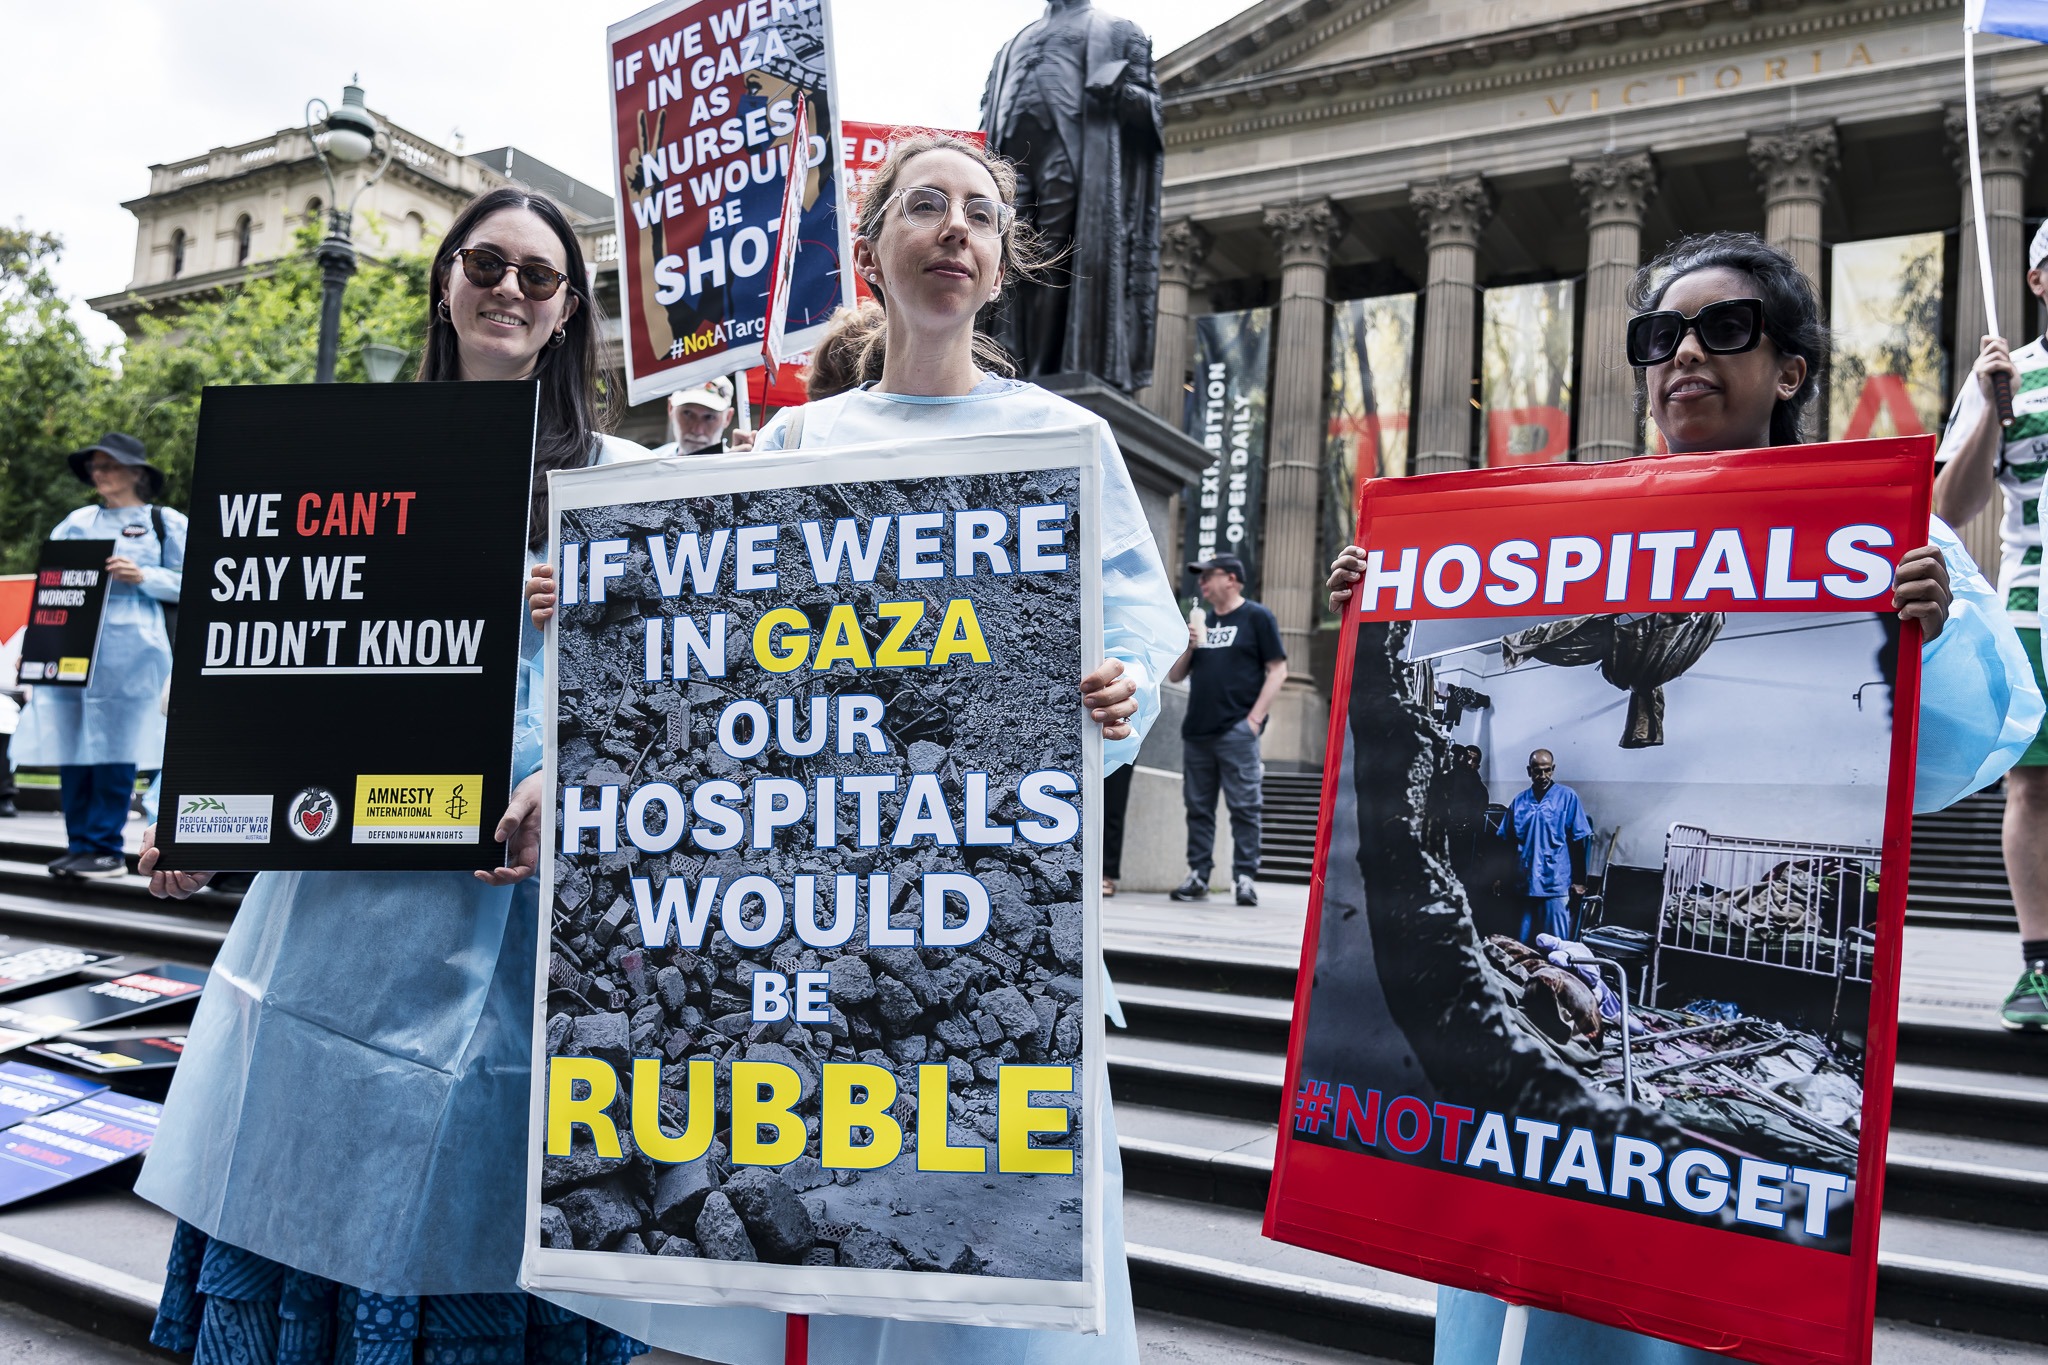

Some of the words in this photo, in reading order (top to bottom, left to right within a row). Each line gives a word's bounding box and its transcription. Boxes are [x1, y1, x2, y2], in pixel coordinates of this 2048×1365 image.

[615, 51, 643, 91] IF
[648, 22, 703, 73] WE
[648, 67, 683, 112] IN
[690, 28, 789, 91] GAZA
[1545, 41, 1875, 117] VICTORIA
[689, 86, 730, 127] AS
[642, 99, 796, 188] NURSES
[632, 184, 684, 230] WE
[708, 199, 743, 232] BE
[1230, 395, 1250, 467] DAILY
[219, 493, 282, 538] WE
[295, 491, 417, 537] CAN'T
[1226, 472, 1248, 543] OPEN
[61, 569, 100, 587] HEALTH
[210, 556, 291, 601] SAY
[302, 555, 367, 600] WE
[562, 538, 630, 606] IF
[647, 524, 779, 598] WE
[801, 504, 1069, 584] WERE
[1361, 523, 1895, 612] HOSPITALS
[34, 609, 68, 625] KILLED
[38, 589, 86, 607] WORKERS
[205, 620, 347, 667] DIDN'T
[358, 619, 485, 666] KNOW
[645, 613, 728, 682] IN
[752, 598, 993, 673] GAZA
[717, 693, 889, 760] OUR
[180, 816, 208, 824] MEDICAL
[210, 816, 254, 824] ASSOCIATION
[255, 816, 269, 824] FOR
[366, 806, 433, 818] INTERNATIONAL
[367, 787, 435, 804] AMNESTY
[562, 769, 1081, 854] HOSPITALS
[179, 823, 233, 833] PREVENTION
[235, 823, 247, 833] OF
[249, 823, 269, 833] WAR
[368, 830, 408, 840] DEFENDING
[409, 830, 436, 840] HUMAN
[436, 830, 464, 840] RIGHTS
[630, 872, 991, 948] WOULD
[752, 970, 831, 1024] BE
[546, 1056, 1076, 1174] RUBBLE
[1295, 1079, 1849, 1238] #NOTATARGET
